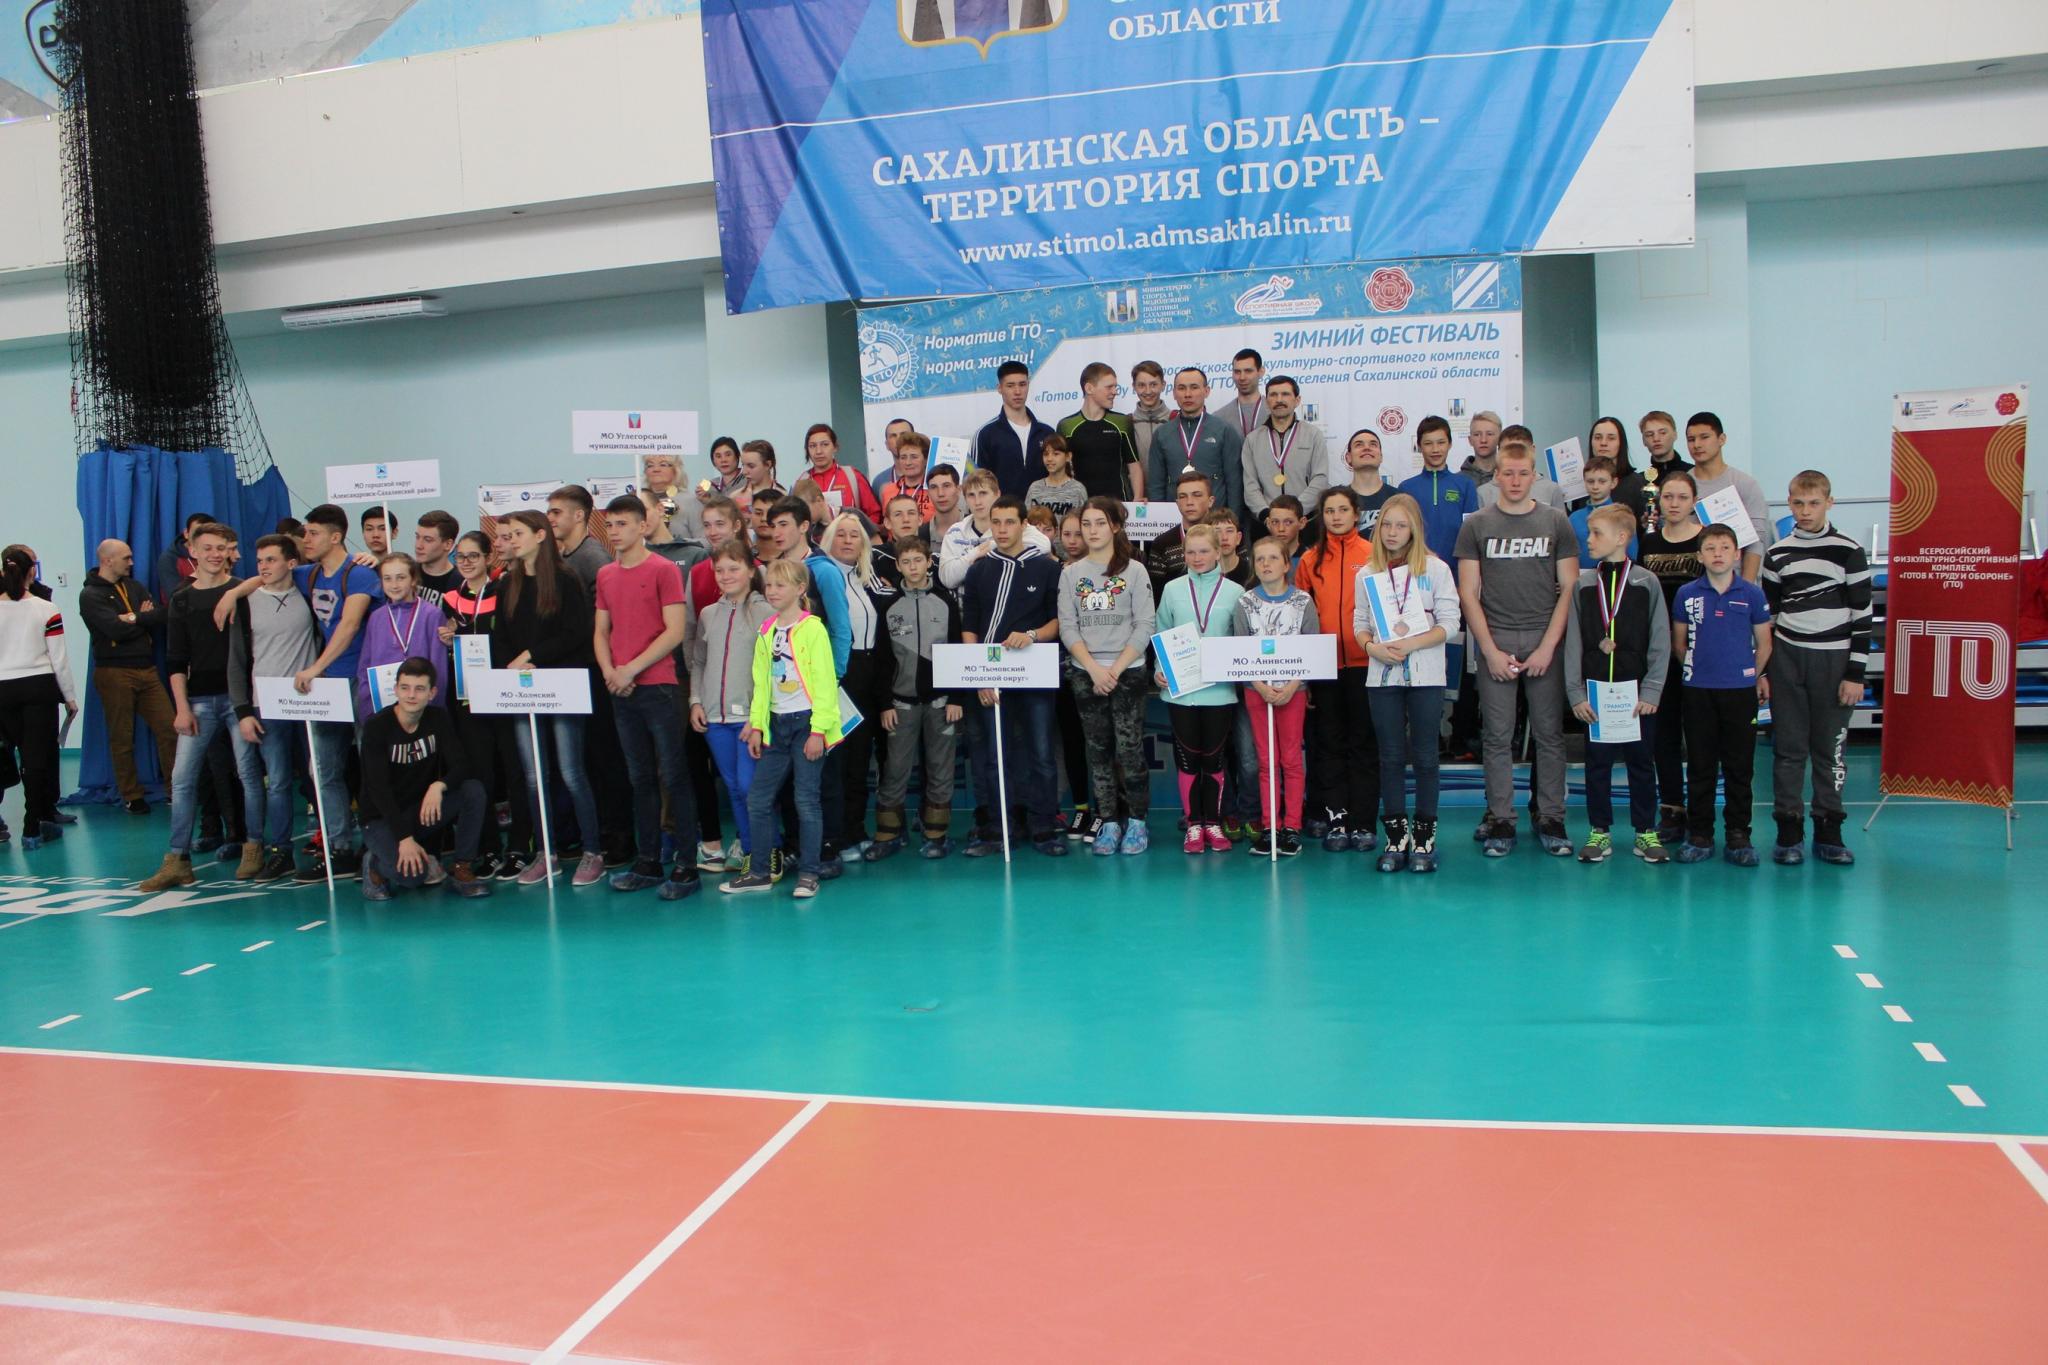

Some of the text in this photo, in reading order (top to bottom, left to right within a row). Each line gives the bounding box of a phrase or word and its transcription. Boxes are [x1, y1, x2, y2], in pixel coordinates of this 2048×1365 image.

[1108, 1, 1281, 41] ОБЛАСТИ
[872, 125, 1188, 186] САХАЛИНСКАЯ
[1204, 106, 1404, 153] ОБЛАСТЬ
[923, 153, 1383, 223] ТЕРРИТОРИЯ СПОРТА
[959, 212, 1352, 264] www.stimol.admsakhalin.ru
[924, 330, 1006, 352] Норматив
[1011, 322, 1041, 341] ГТО
[1271, 321, 1500, 351] ЗИМНИЙ ФЕСТИВАЛЬ
[1430, 348, 1500, 366] комплекса
[925, 359, 974, 376] норма
[1353, 366, 1439, 383] Сахалинской
[1442, 364, 1500, 380] области
[601, 432, 667, 441] МО Углегорский
[1486, 538, 1551, 558] ILLEGAL
[1920, 546, 1991, 555] ВСЕРОССИЙСКИЙ
[1893, 555, 2018, 563] ФИЗКУЛЬТУРНО-СПОРТИВНЫЙ
[1943, 581, 1963, 589] (ГТО)
[1894, 619, 2010, 701] ГТО
[1227, 668, 1311, 677] городской округ»
